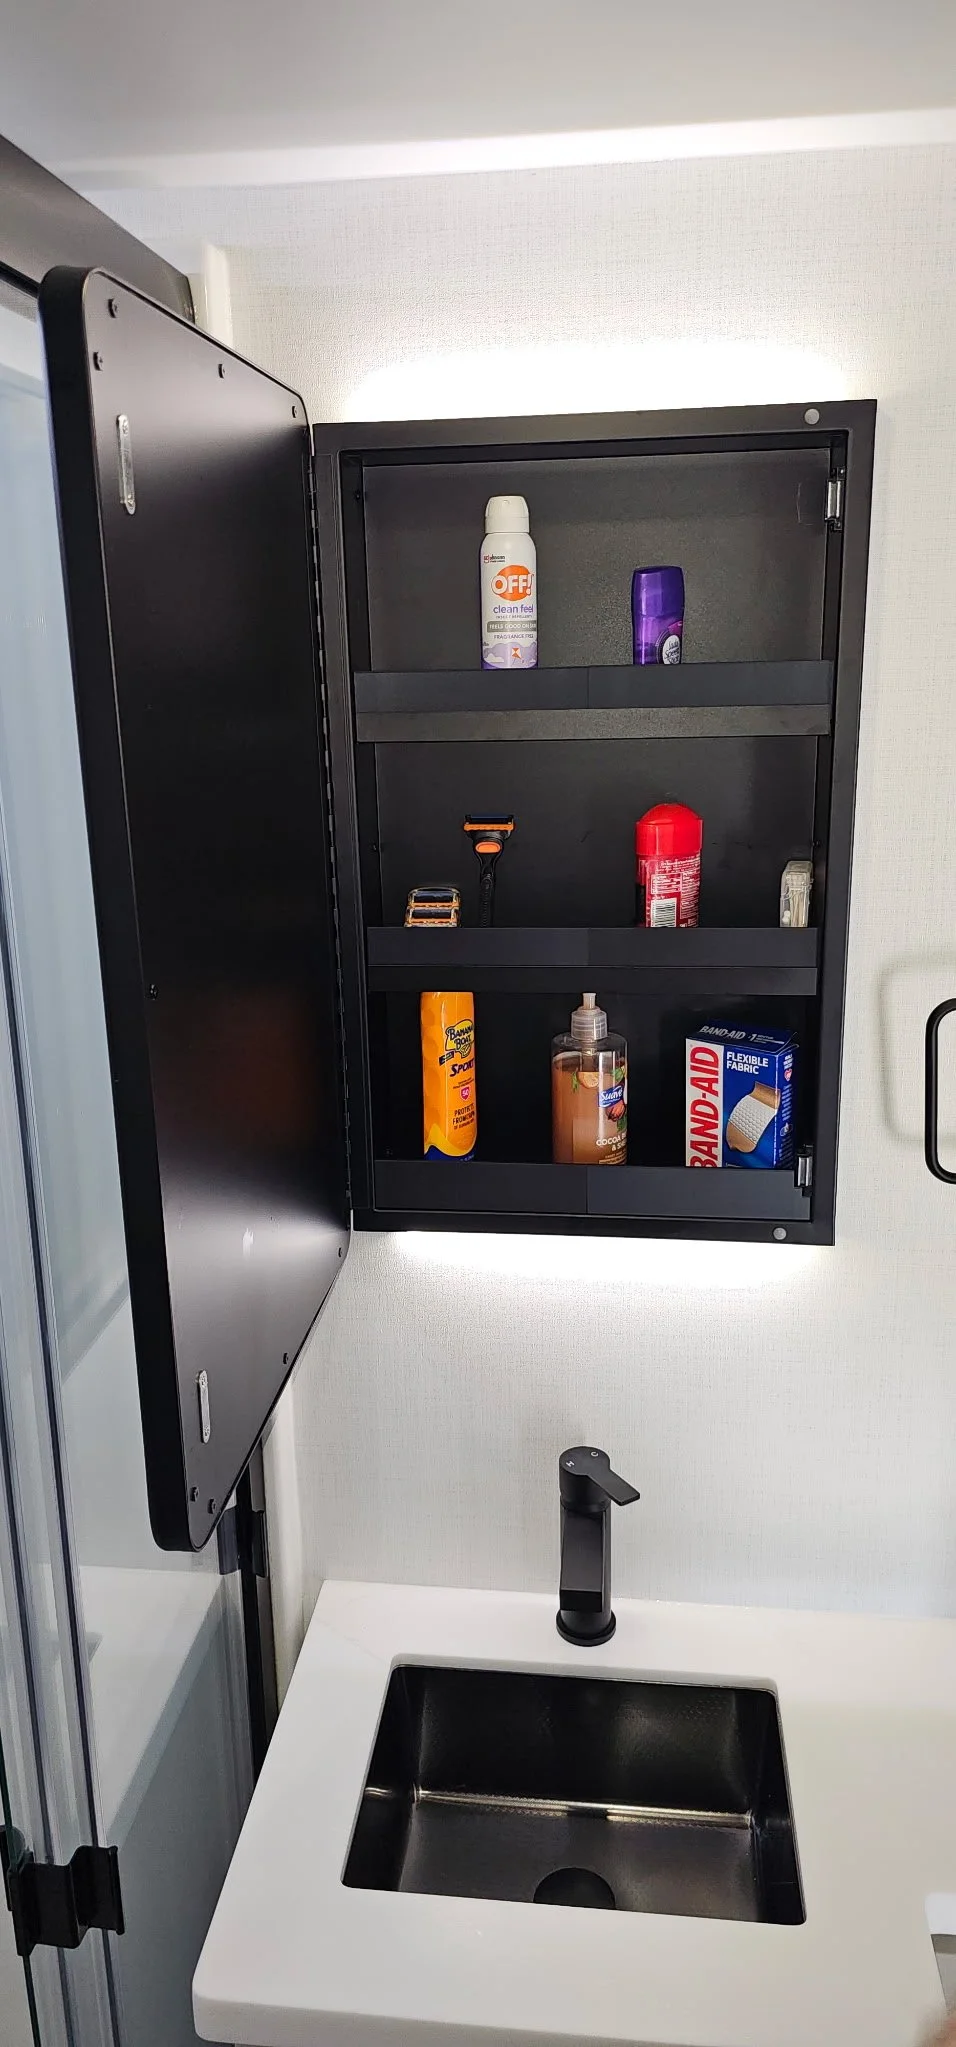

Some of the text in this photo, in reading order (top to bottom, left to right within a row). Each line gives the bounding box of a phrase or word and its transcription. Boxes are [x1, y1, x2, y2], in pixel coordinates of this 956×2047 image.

[491, 573, 532, 596] OFF!
[493, 604, 533, 614] clean feel
[699, 1025, 746, 1040] BAND-AID
[726, 1051, 769, 1067] FLEXIBLE
[726, 1060, 759, 1075] FABRIC
[601, 1088, 622, 1101] Suave
[596, 1134, 621, 1146] COCOA
